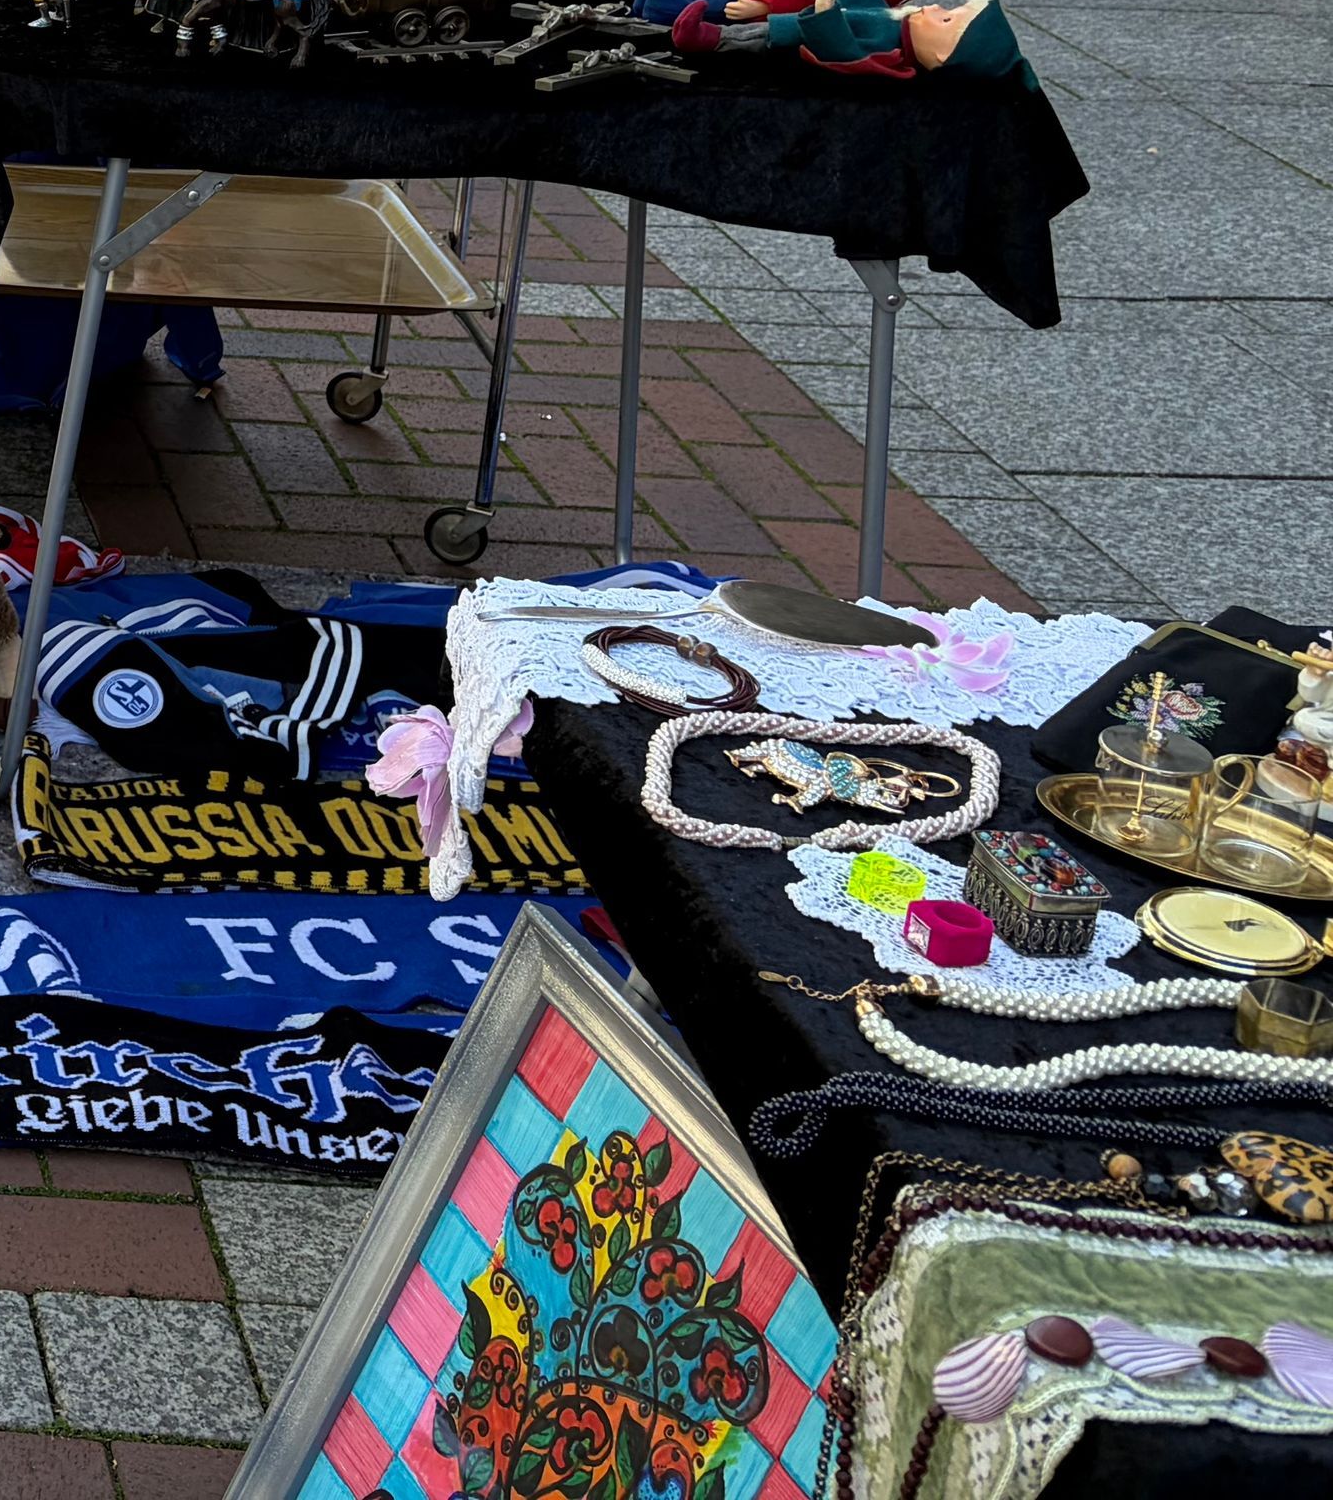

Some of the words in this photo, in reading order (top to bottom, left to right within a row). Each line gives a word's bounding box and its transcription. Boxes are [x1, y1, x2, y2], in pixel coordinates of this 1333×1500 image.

[52, 779, 184, 801] TADION
[186, 916, 397, 986] FC
[16, 1089, 213, 1134] Liebe
[225, 1101, 406, 1163] Unse
